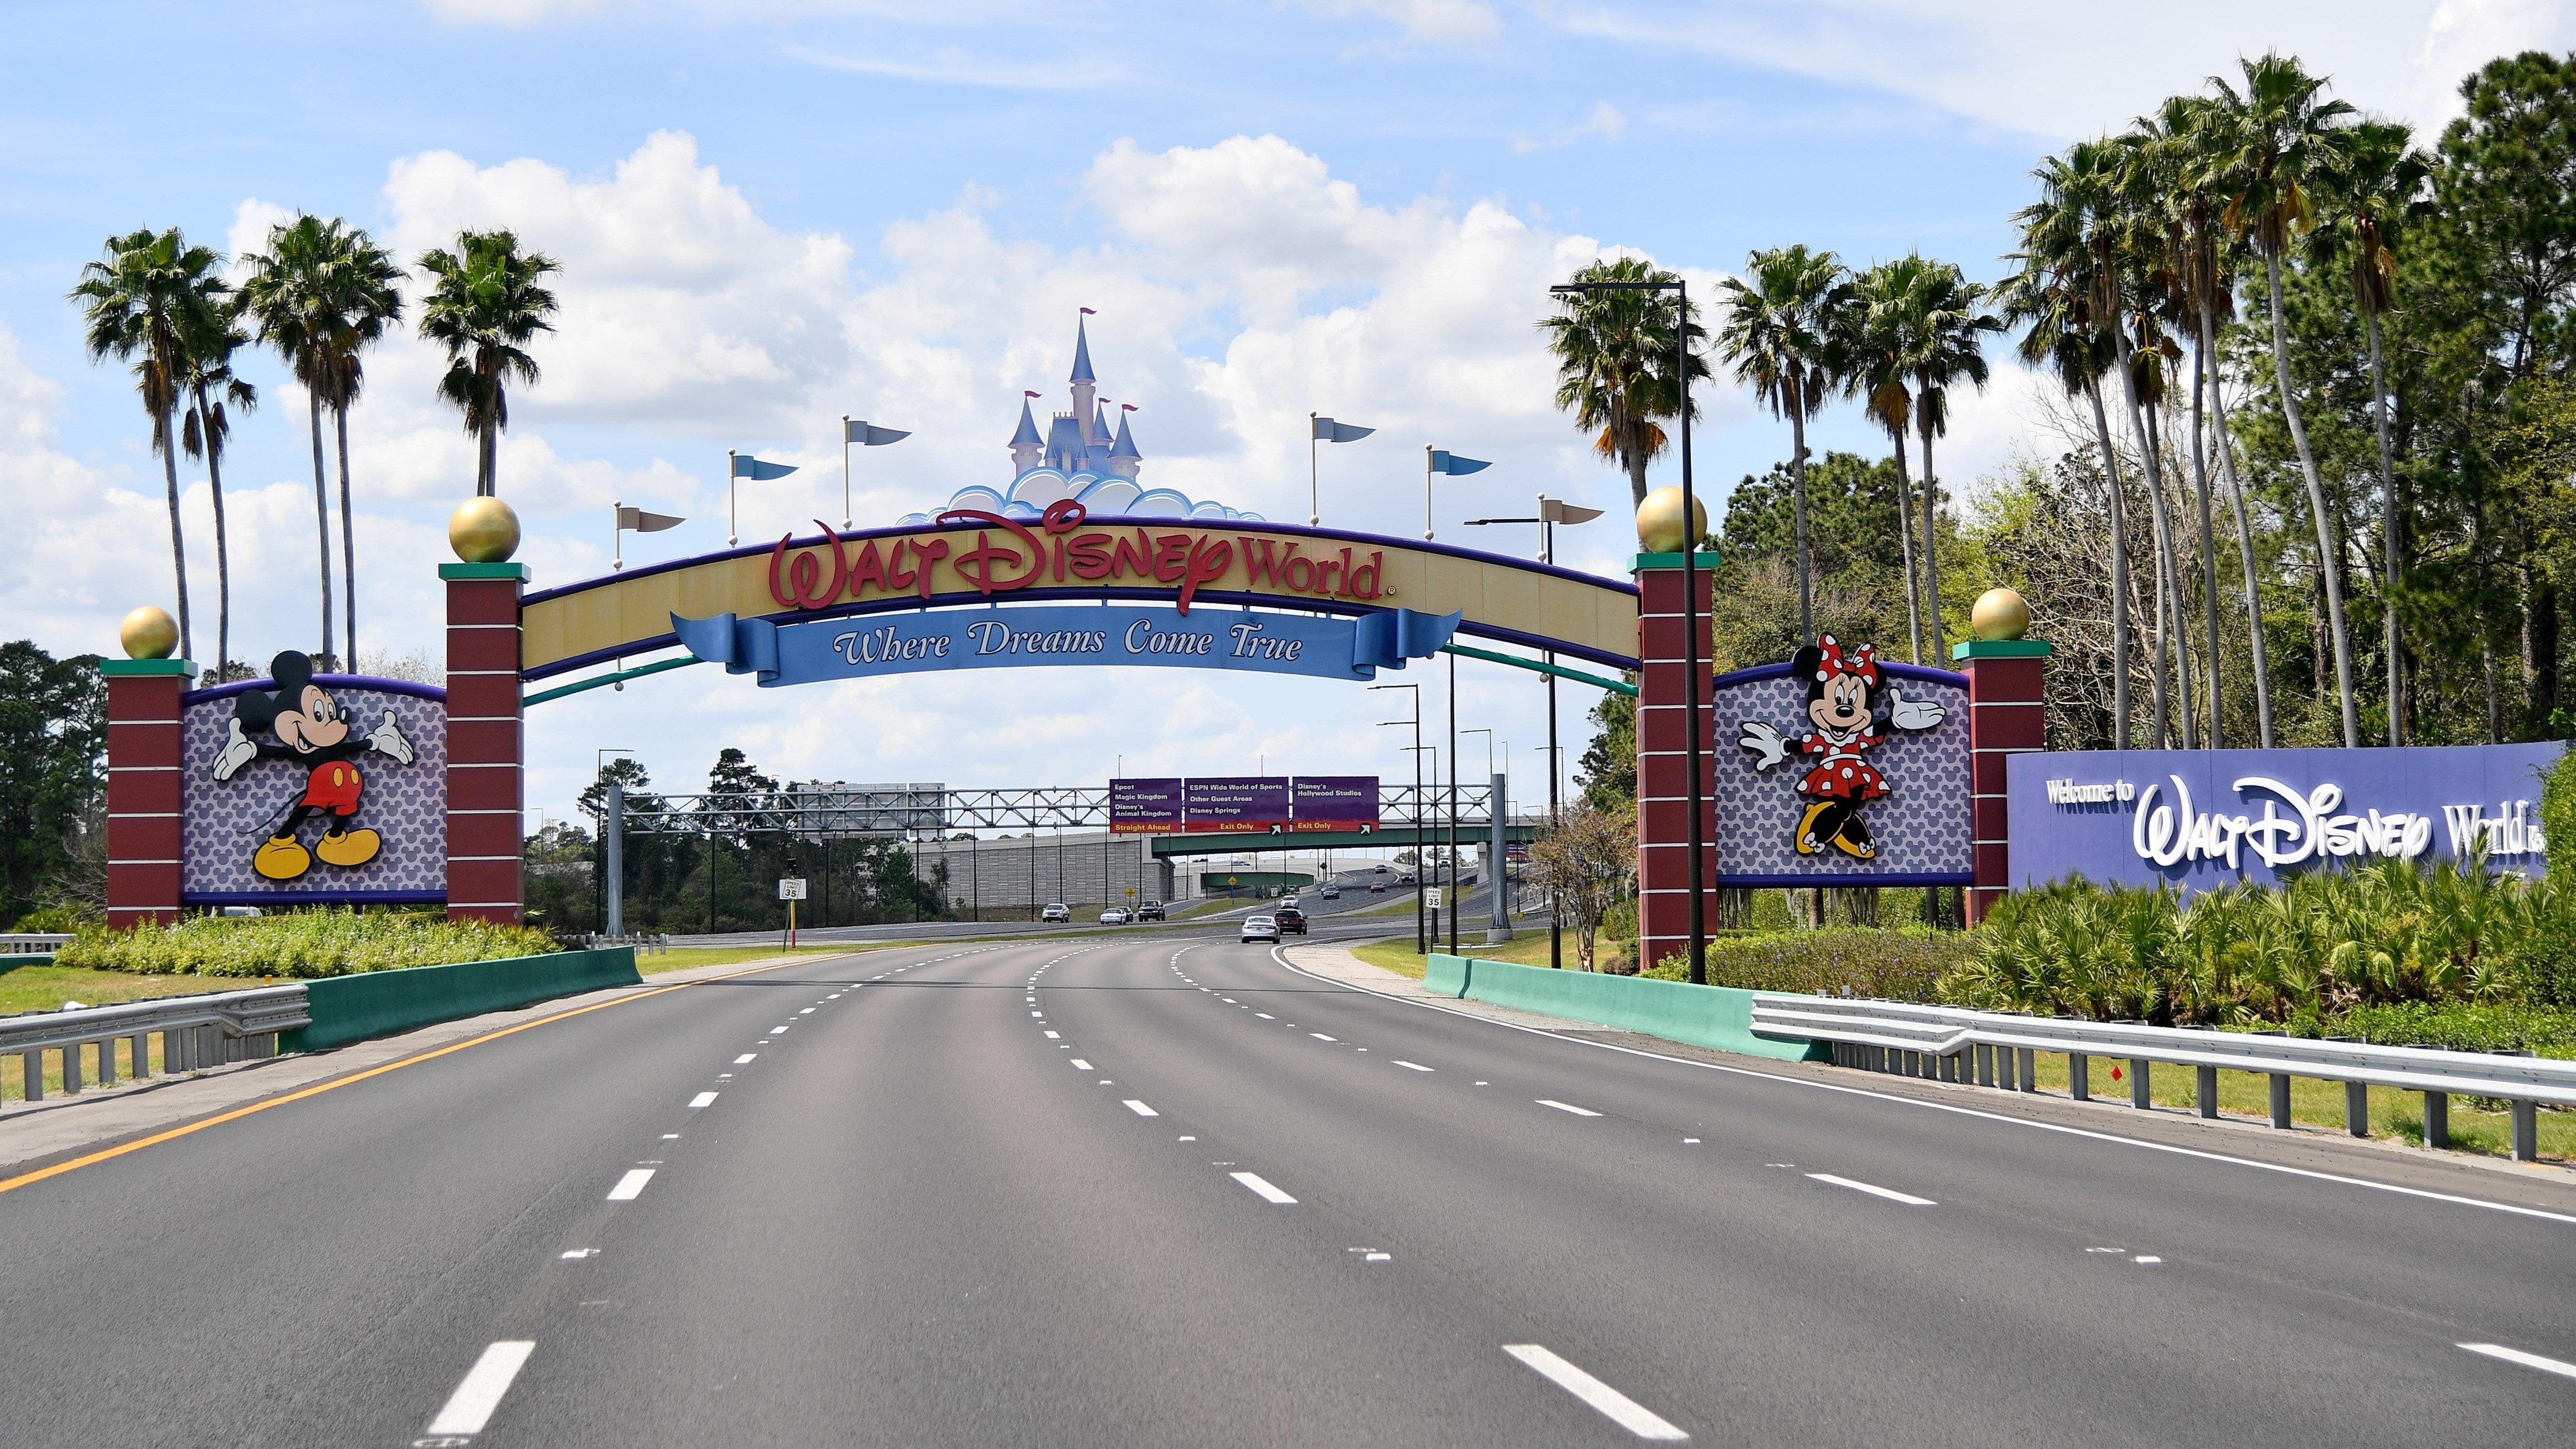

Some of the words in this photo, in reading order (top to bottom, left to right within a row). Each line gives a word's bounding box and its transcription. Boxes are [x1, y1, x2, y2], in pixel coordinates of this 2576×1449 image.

[833, 626, 951, 665] Where
[967, 621, 1107, 656] Dreams
[1124, 619, 1213, 655] Come
[1230, 623, 1303, 661] True
[2046, 778, 2115, 804] Welcome
[2115, 779, 2135, 801] to
[785, 889, 797, 897] 35
